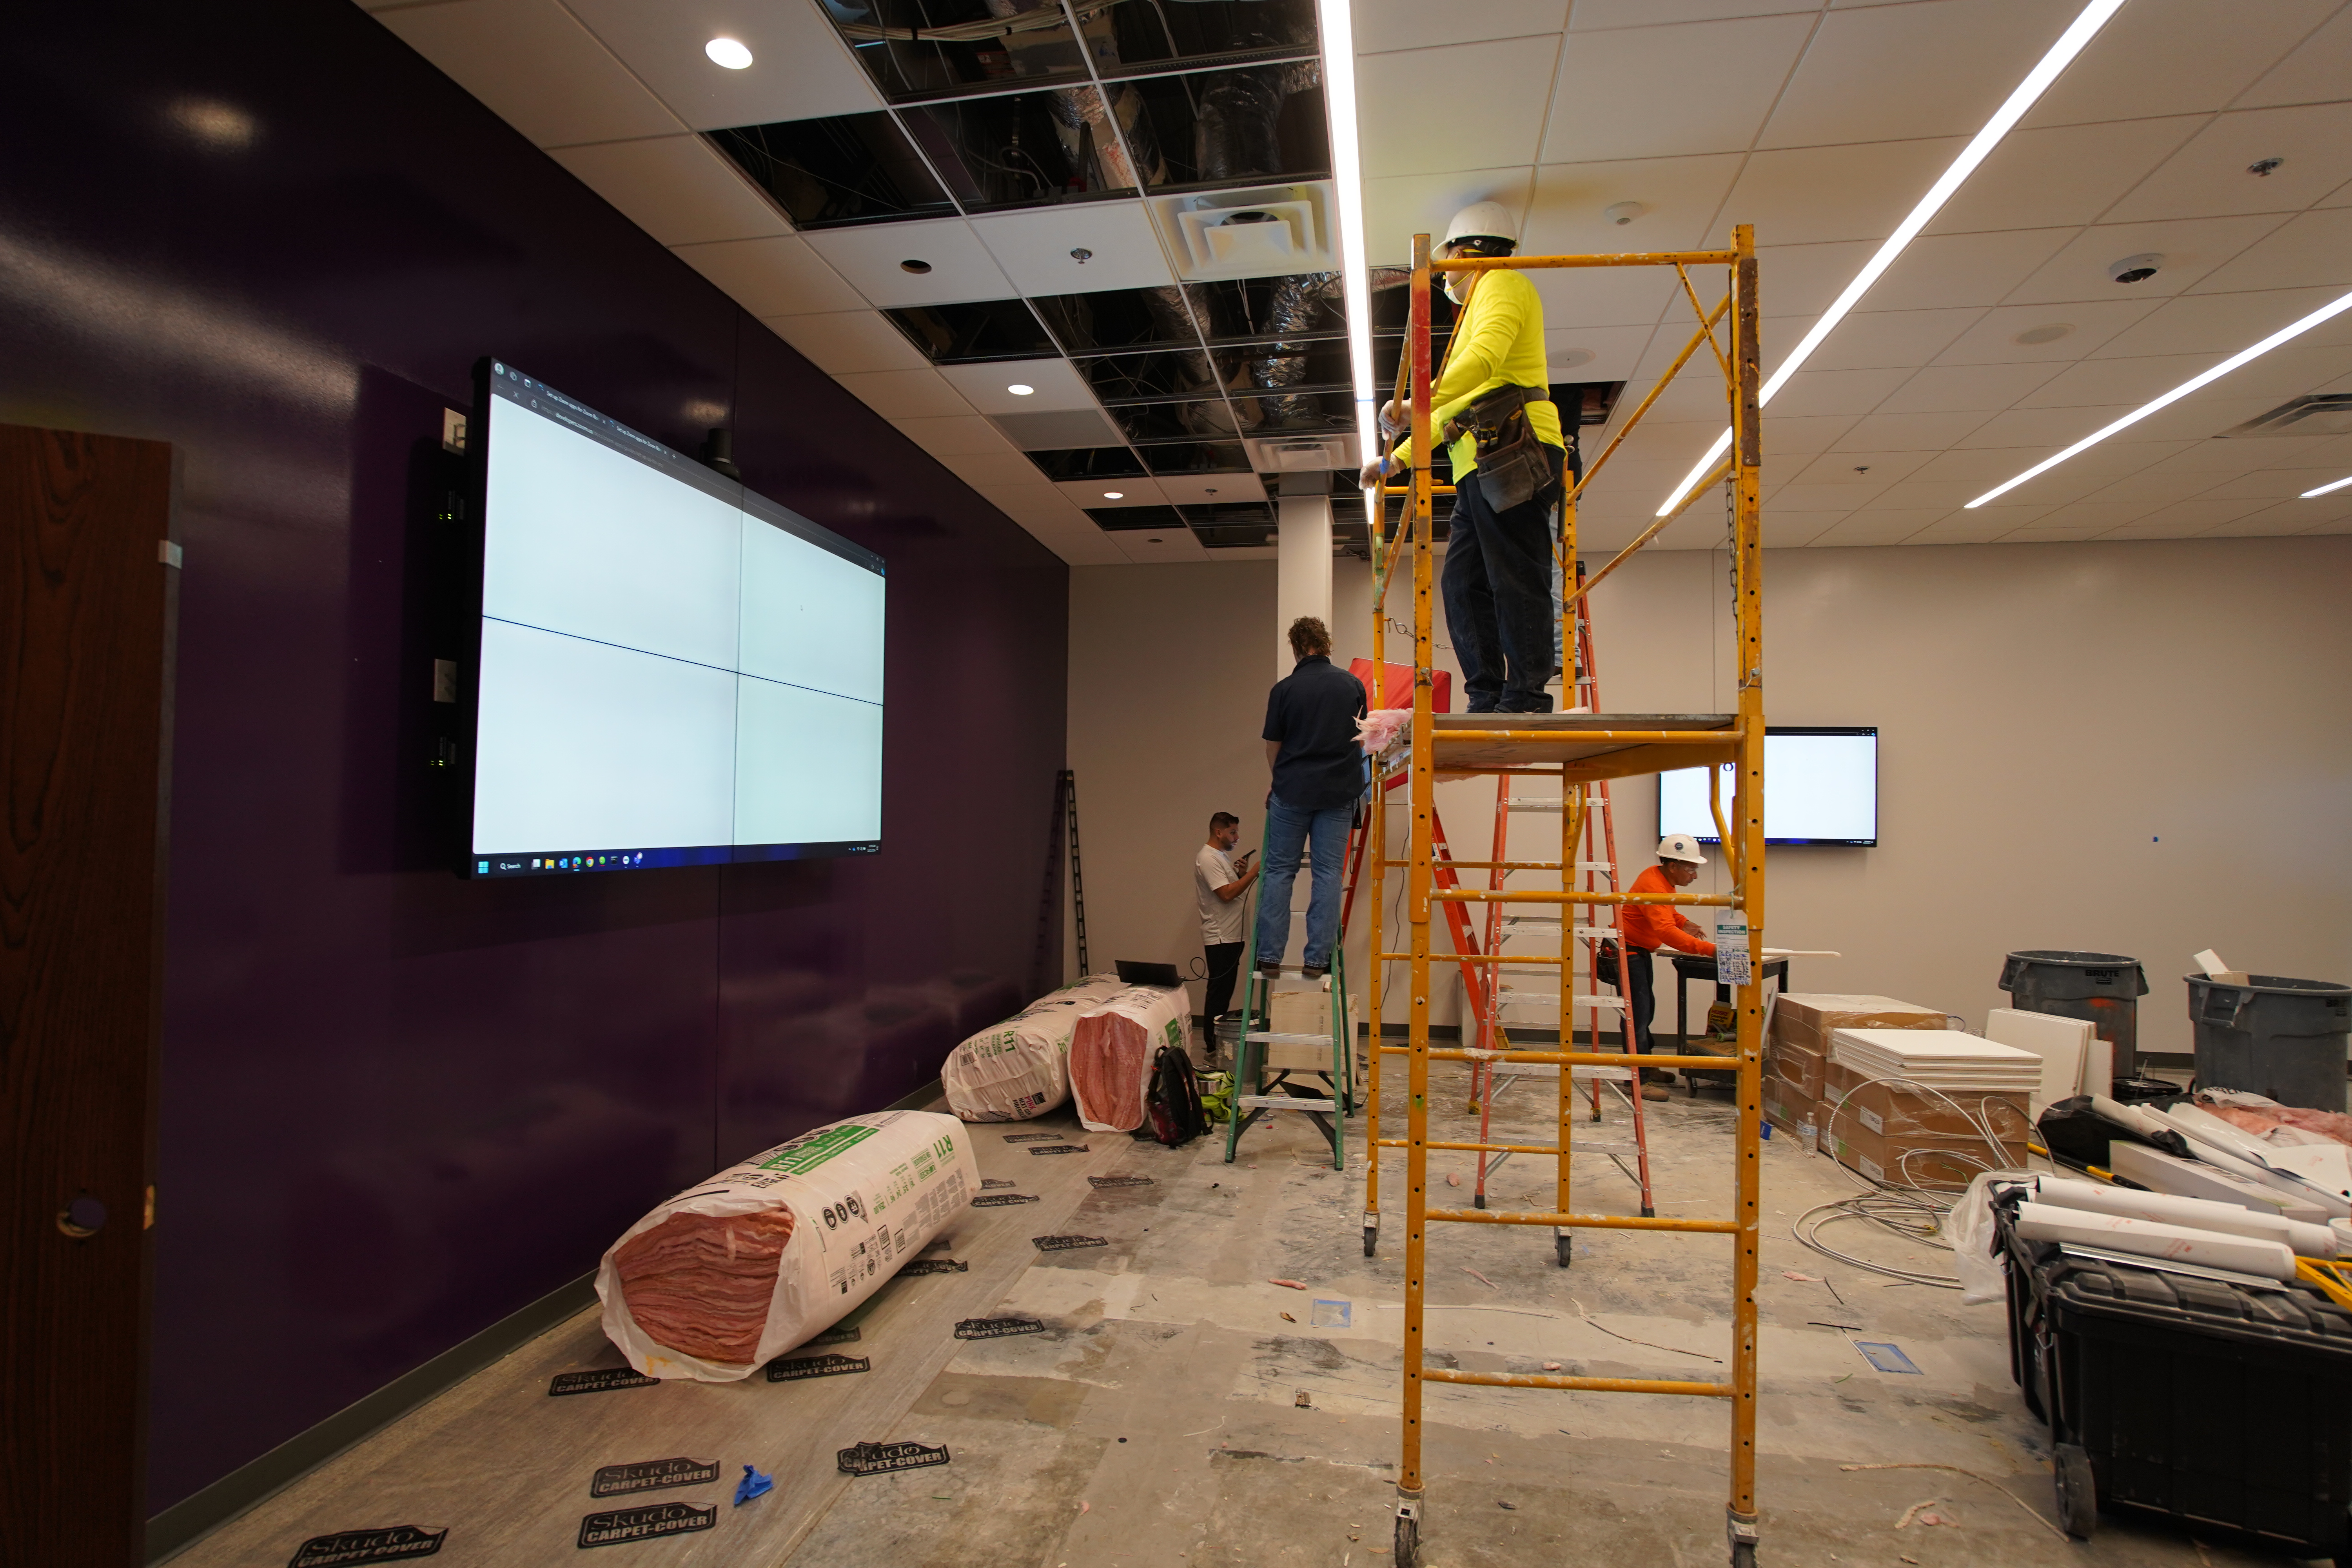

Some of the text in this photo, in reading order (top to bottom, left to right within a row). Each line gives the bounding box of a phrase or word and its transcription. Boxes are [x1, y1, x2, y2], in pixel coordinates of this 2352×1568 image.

[1004, 1031, 1016, 1052] R11
[1018, 1097, 1027, 1109] NEXT
[1024, 1096, 1036, 1110] PINK
[933, 1134, 953, 1159] R11
[768, 1156, 803, 1170] R11
[773, 1363, 863, 1379] CARPET-COVER
[775, 1357, 845, 1370] Skudo
[557, 1376, 654, 1392] CARPET-COVER
[599, 1470, 711, 1492] CARPET-COVER
[603, 1463, 691, 1481] Skudo
[590, 1508, 686, 1529] Skudo
[587, 1515, 708, 1542] CARPET-COVER
[307, 1532, 414, 1555] Skudo
[297, 1540, 434, 1568] CARPET-COVER
